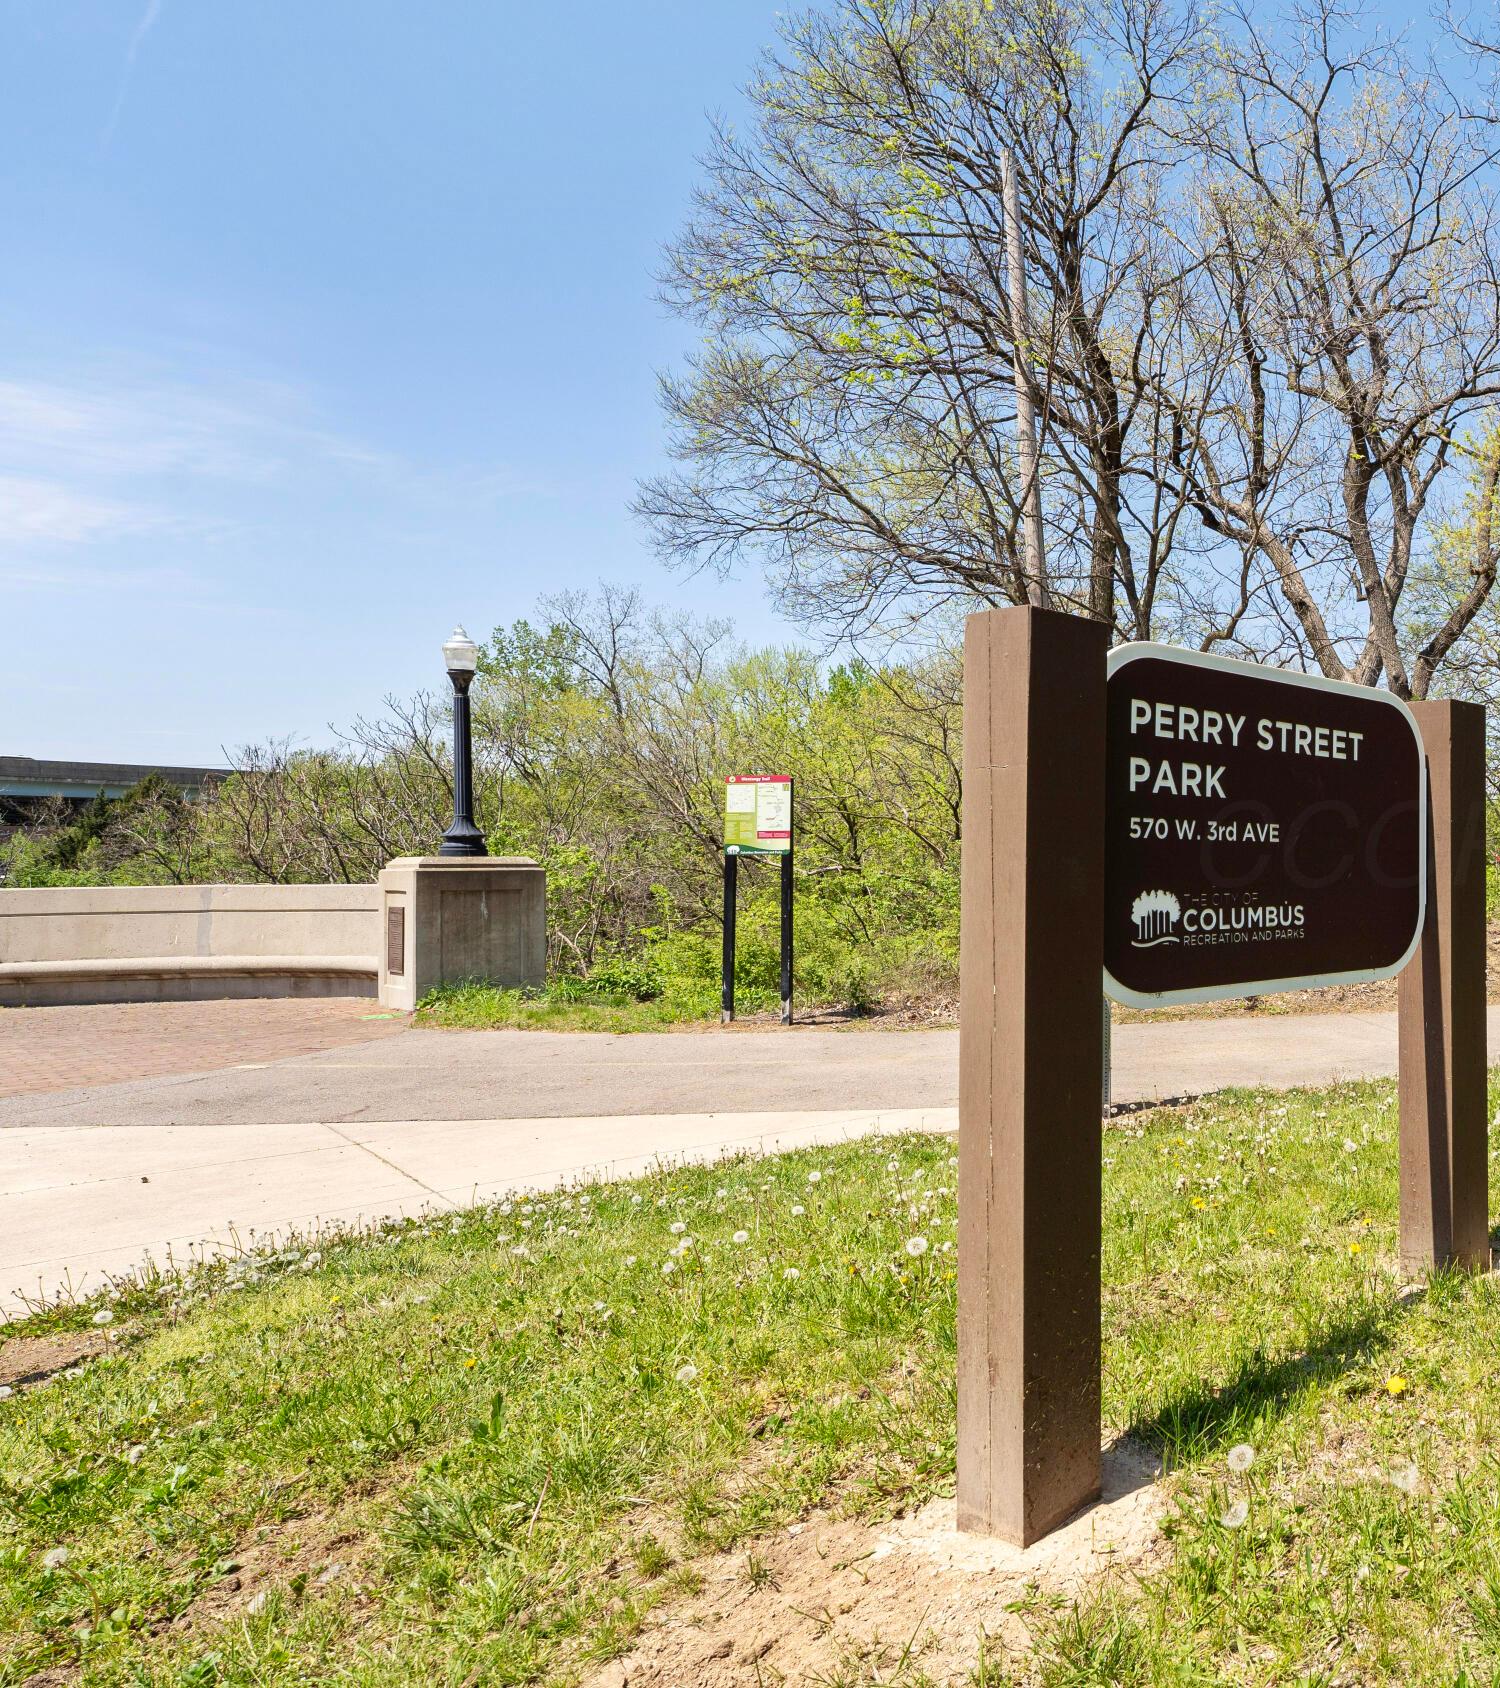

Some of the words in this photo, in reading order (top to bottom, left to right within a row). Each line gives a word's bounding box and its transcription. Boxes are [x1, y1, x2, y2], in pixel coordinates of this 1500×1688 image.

[1130, 698, 1247, 747] PERRY
[1256, 718, 1364, 762] STREET
[1129, 756, 1227, 799] PARK
[1129, 816, 1169, 840] 570
[1175, 819, 1201, 841] W.
[1207, 821, 1237, 842] 3rd
[1242, 823, 1280, 843] AVE
[1183, 904, 1305, 932] COLUMBUS
[1183, 932, 1249, 947] RECREATION
[1252, 930, 1273, 942] AND
[1275, 928, 1305, 940] PARKS
